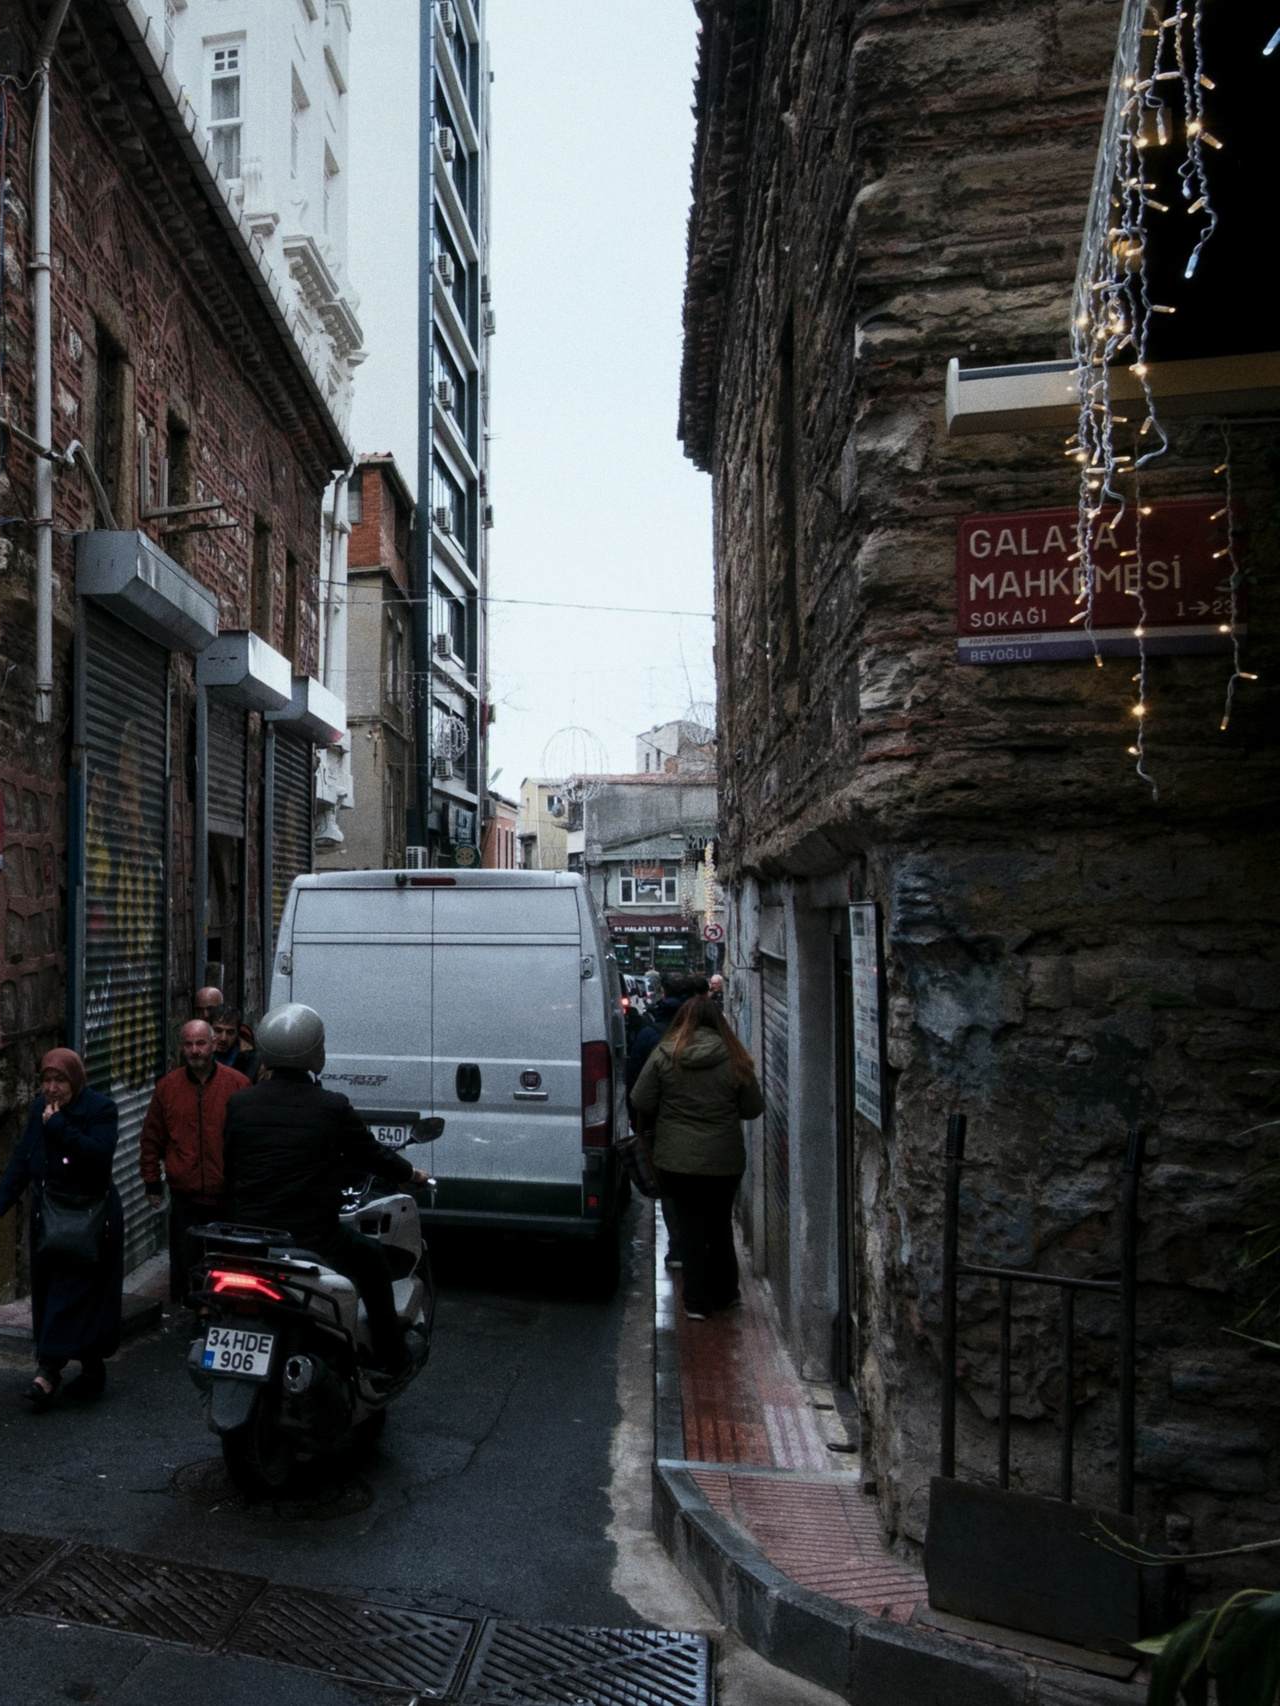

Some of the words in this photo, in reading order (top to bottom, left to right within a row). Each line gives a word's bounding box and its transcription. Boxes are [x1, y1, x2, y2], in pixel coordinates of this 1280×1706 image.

[970, 606, 1047, 628] SOKAĞI
[970, 647, 1032, 662] BEYOĞLU
[378, 1127, 402, 1142] 640
[209, 1329, 230, 1348] 34
[232, 1331, 272, 1354] HDE
[220, 1350, 254, 1371] 906
